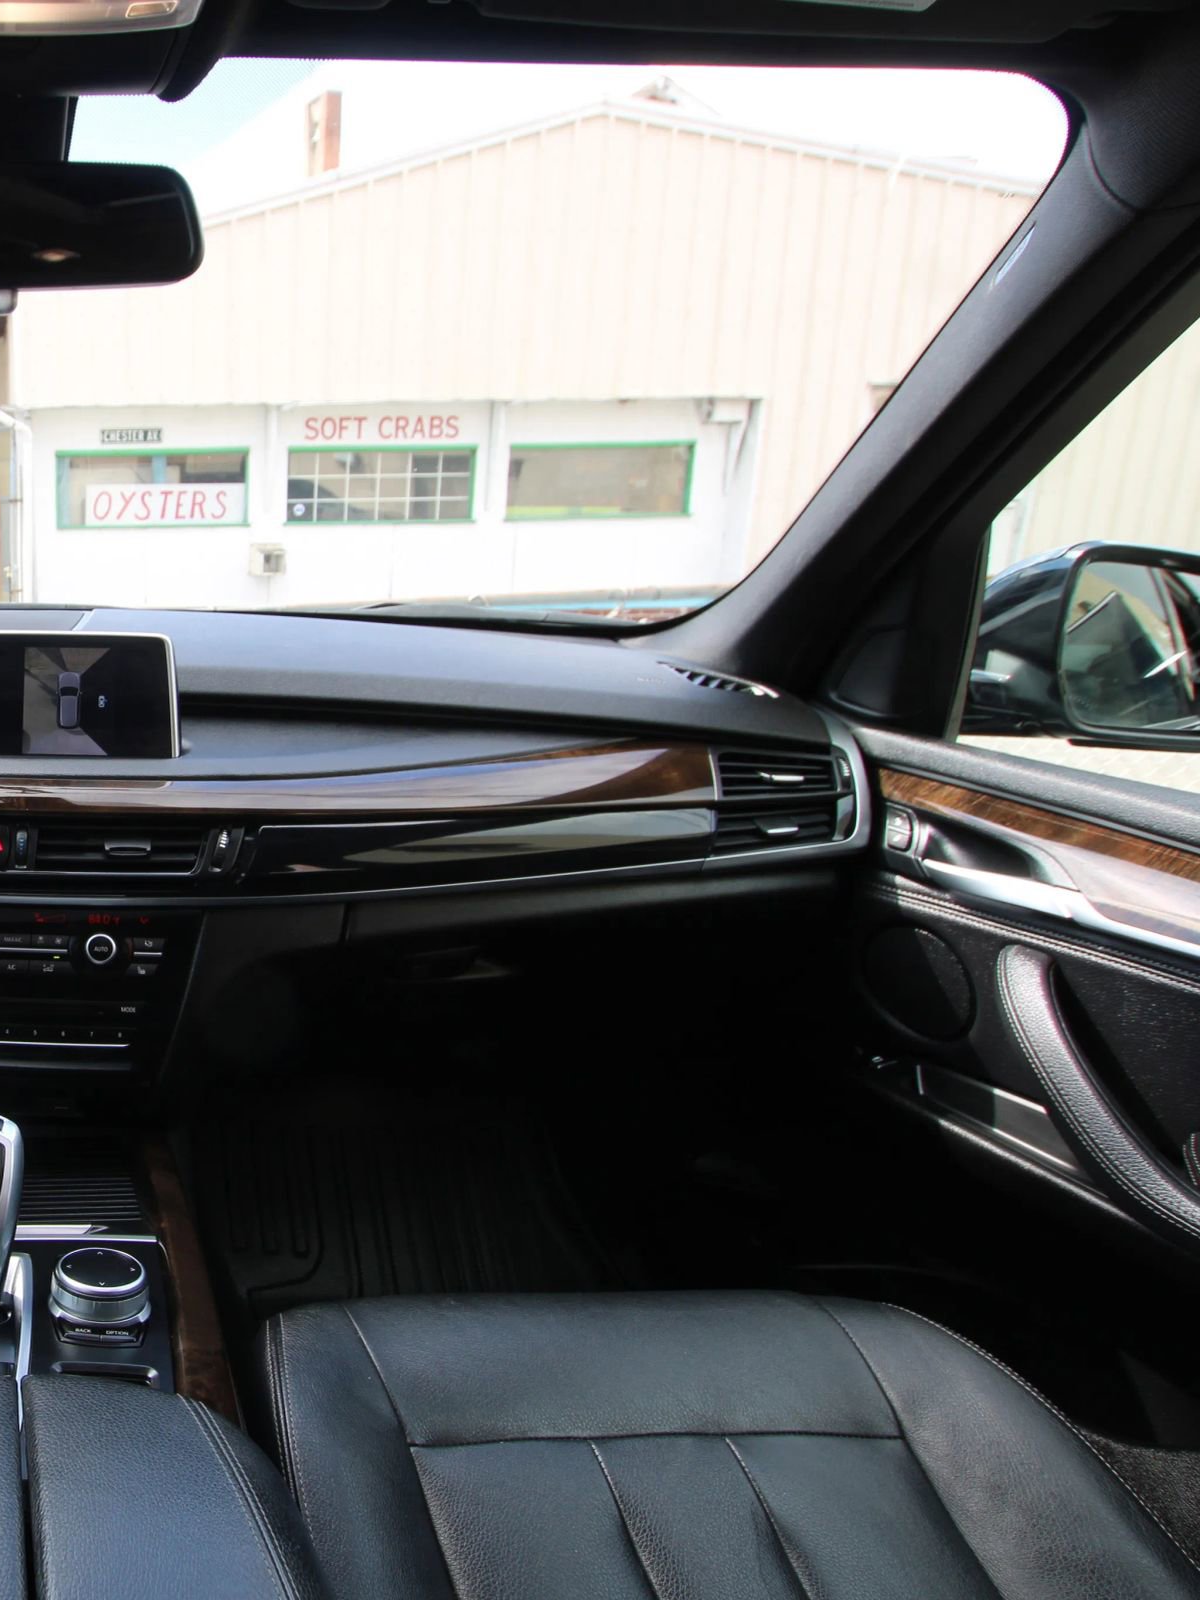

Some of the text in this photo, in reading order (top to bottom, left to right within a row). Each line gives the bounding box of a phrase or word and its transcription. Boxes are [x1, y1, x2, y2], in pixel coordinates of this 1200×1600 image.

[104, 430, 144, 441] CHESTER
[304, 415, 459, 440] SOFT CRABS
[93, 490, 227, 521] OYSTERS
